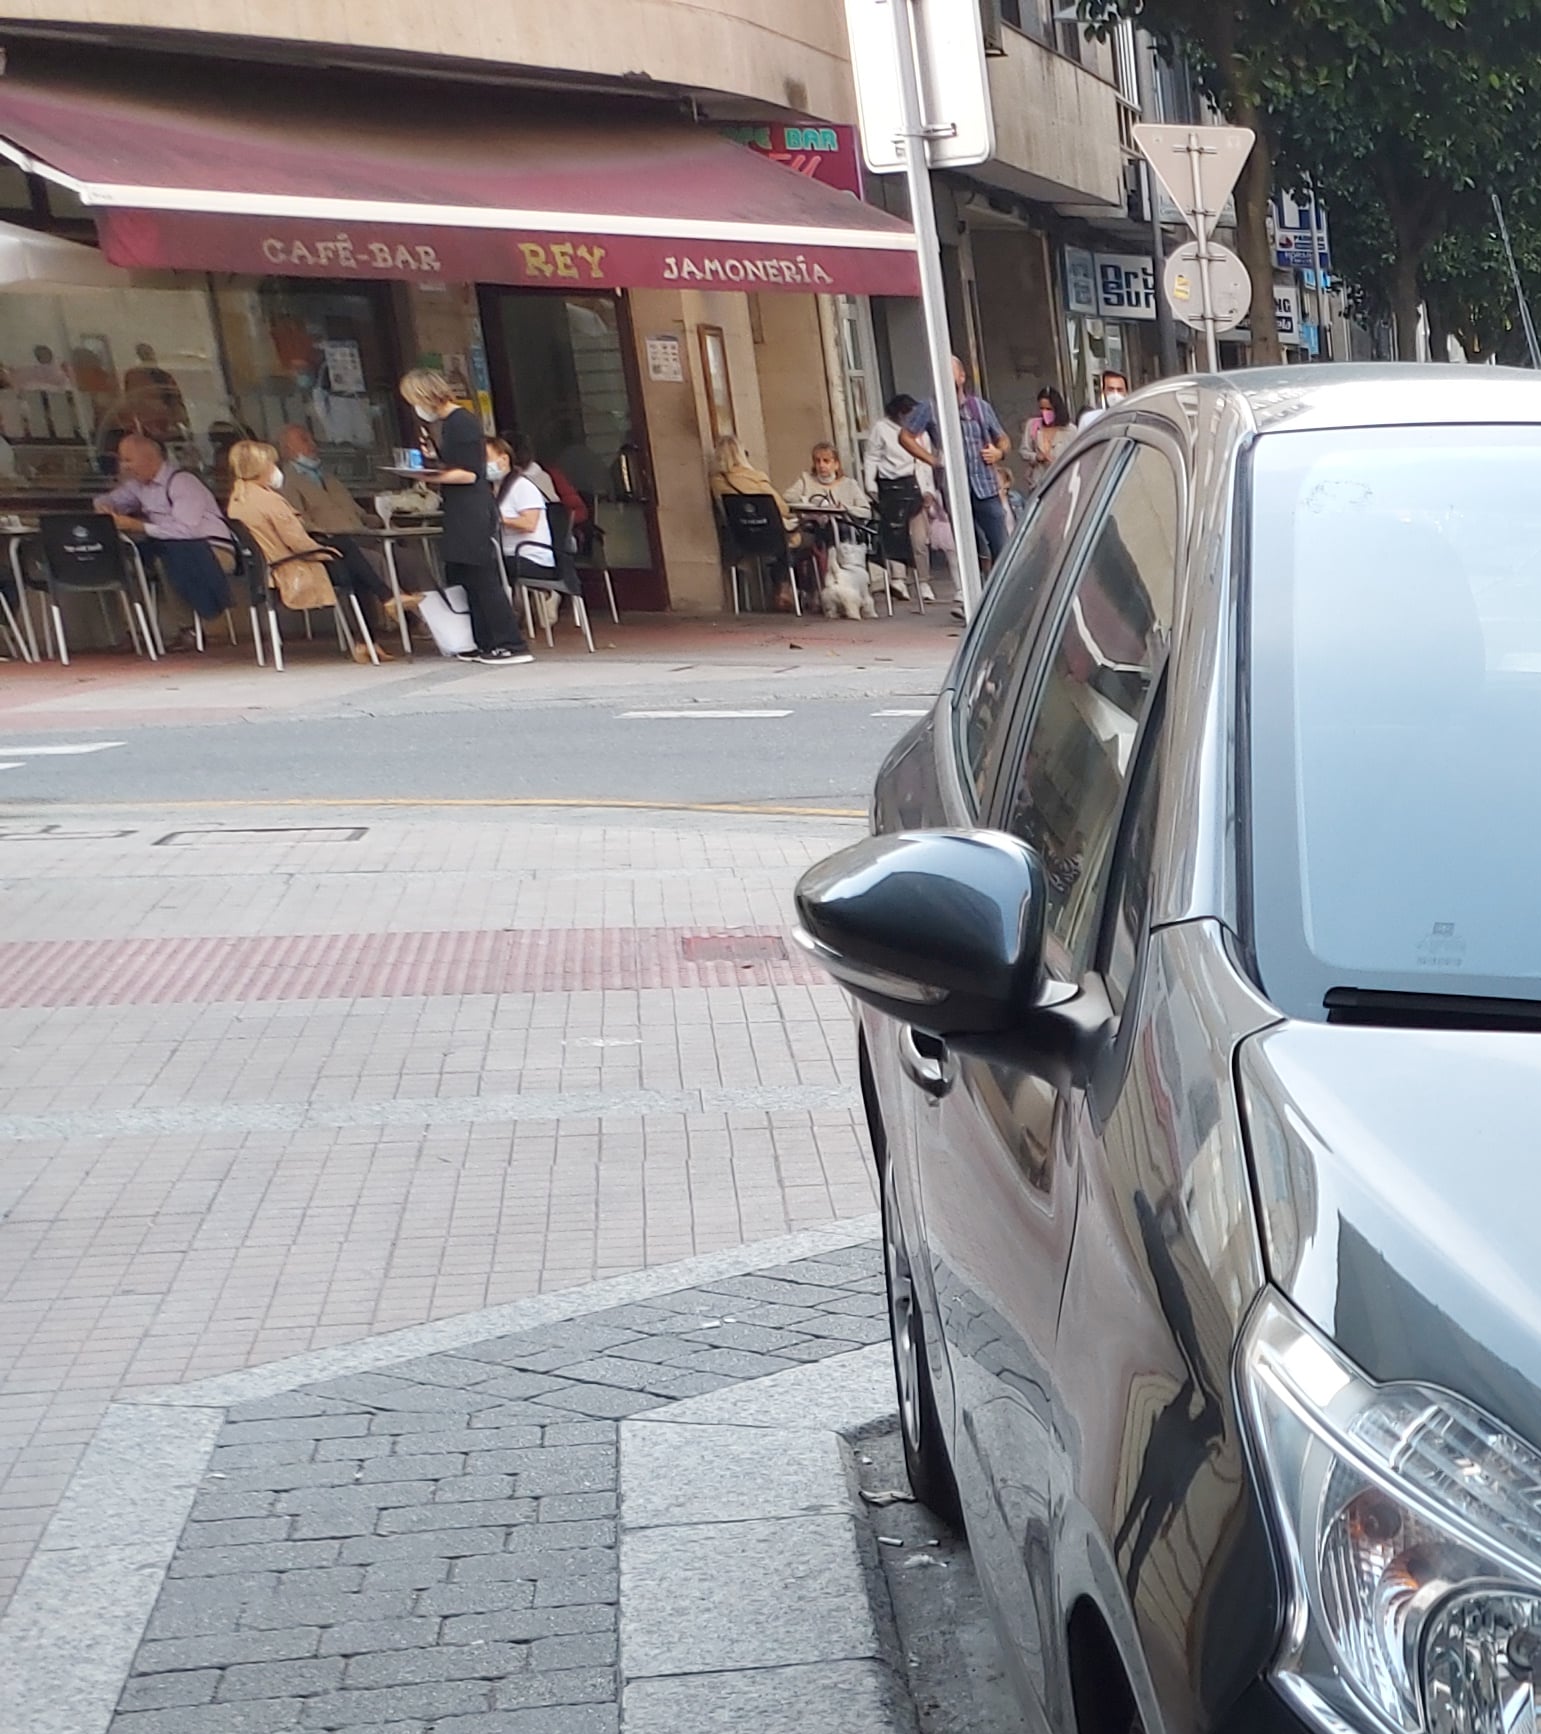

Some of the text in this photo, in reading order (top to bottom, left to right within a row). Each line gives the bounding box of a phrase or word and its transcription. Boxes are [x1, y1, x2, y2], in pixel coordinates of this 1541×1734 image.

[784, 127, 839, 152] BAR
[262, 233, 834, 284] CAFÉ-BAR REY JAMONERÍA
